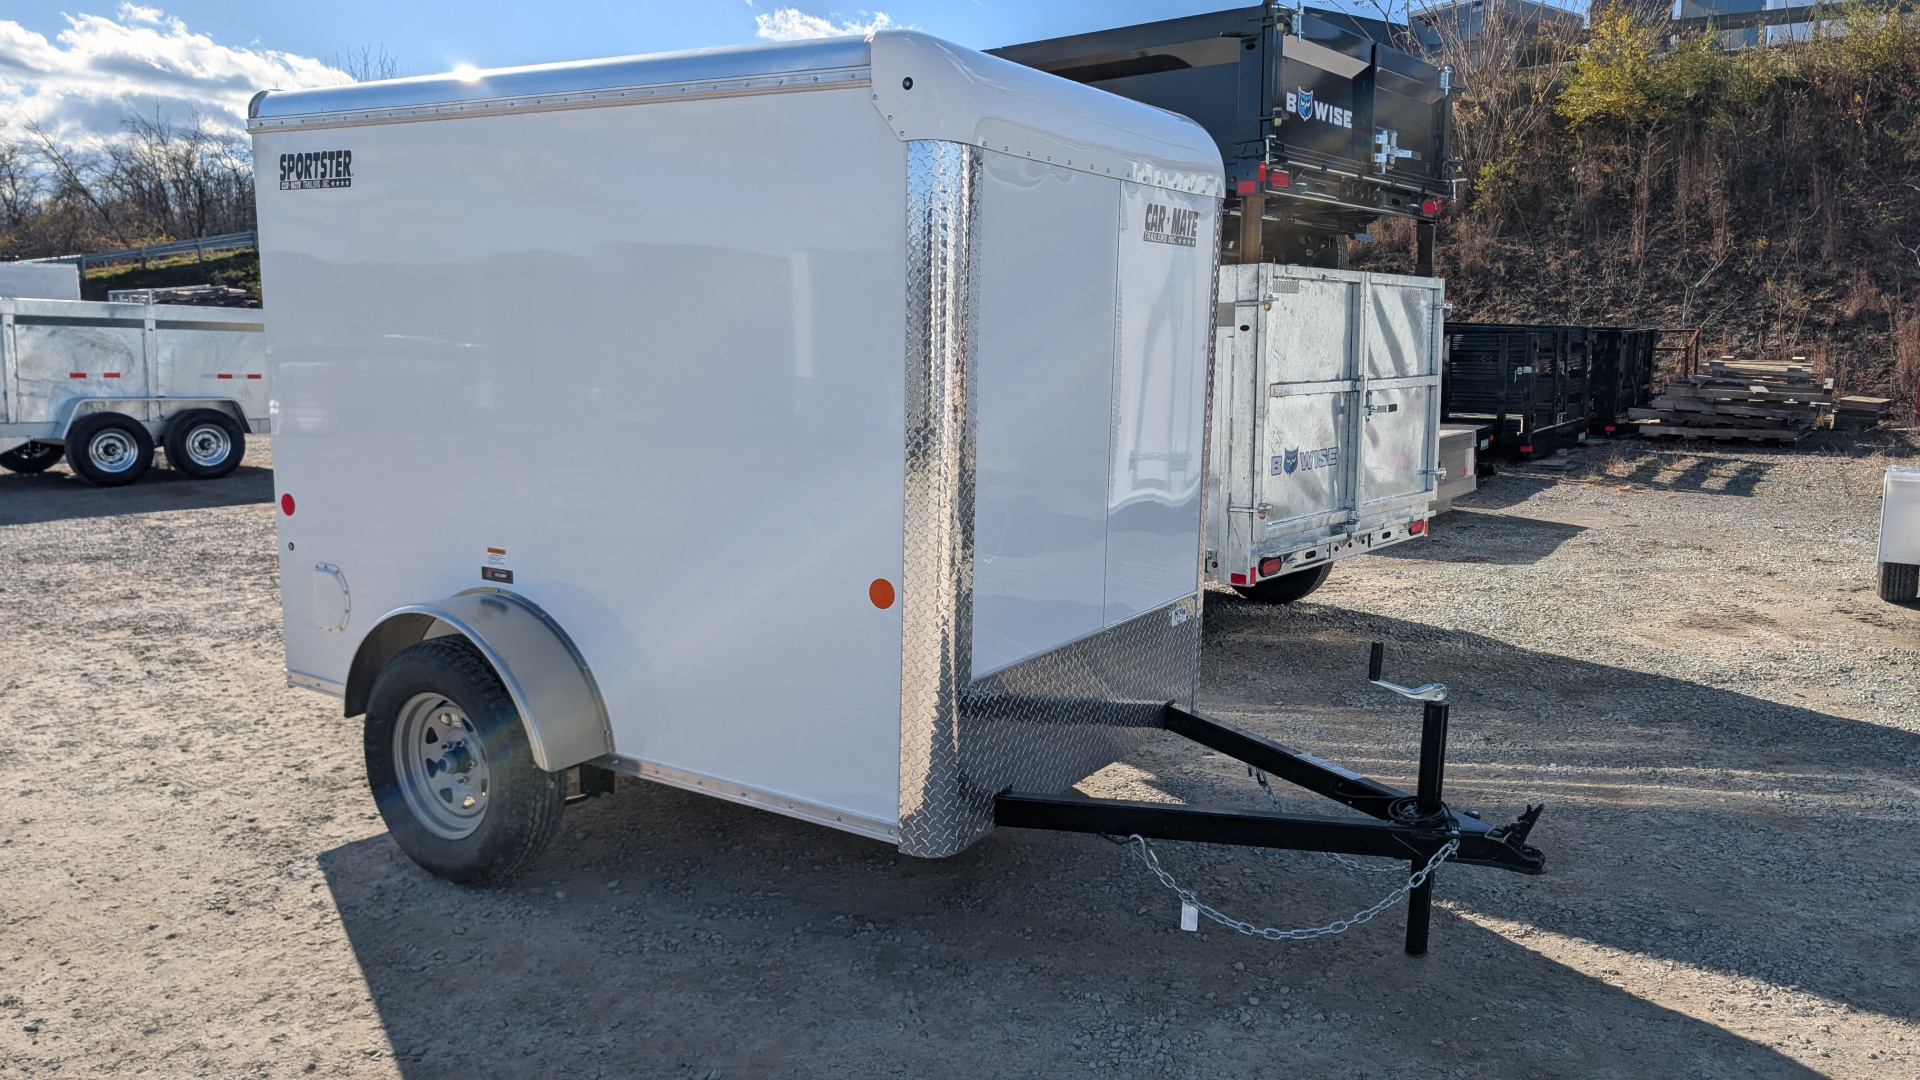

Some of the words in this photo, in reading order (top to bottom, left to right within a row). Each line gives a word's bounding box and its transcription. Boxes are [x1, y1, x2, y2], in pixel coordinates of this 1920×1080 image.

[280, 150, 352, 181] SPORTSTER
[303, 180, 320, 189] TRAILERS
[1145, 232, 1168, 243] TRAILERS
